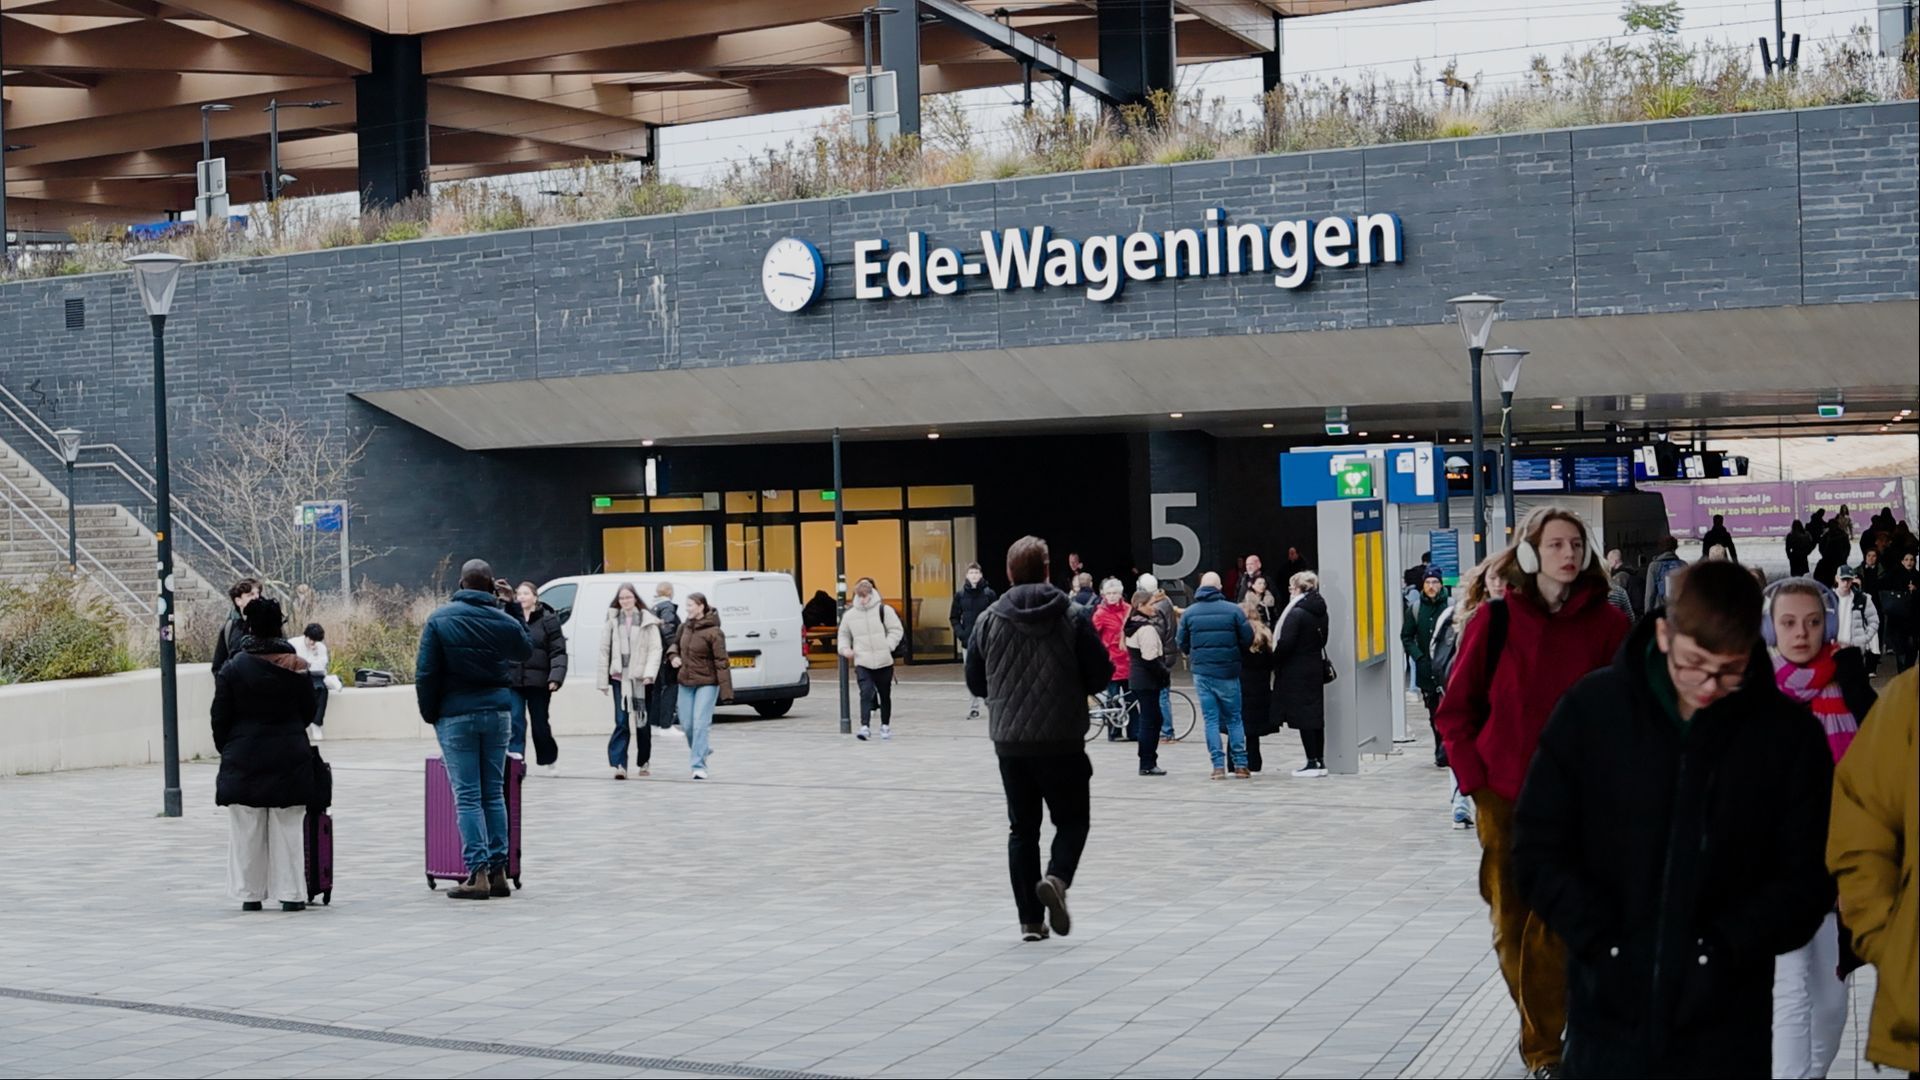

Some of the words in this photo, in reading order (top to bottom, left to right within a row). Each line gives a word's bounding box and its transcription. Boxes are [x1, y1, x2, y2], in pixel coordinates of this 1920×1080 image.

[854, 208, 1402, 301] Ede-Wageningen
[1344, 487, 1365, 495] AED
[1814, 491, 1833, 500] Ede
[1834, 491, 1875, 500] centrum
[1697, 496, 1726, 504] Straks
[1728, 494, 1761, 504] wandel
[1762, 494, 1772, 504] je
[1708, 507, 1726, 516] hier
[1728, 507, 1740, 515] zo
[1741, 506, 1757, 515] het
[1758, 505, 1780, 516] park
[1781, 505, 1791, 513] in
[1859, 500, 1890, 511] perron
[1150, 492, 1201, 580] 5
